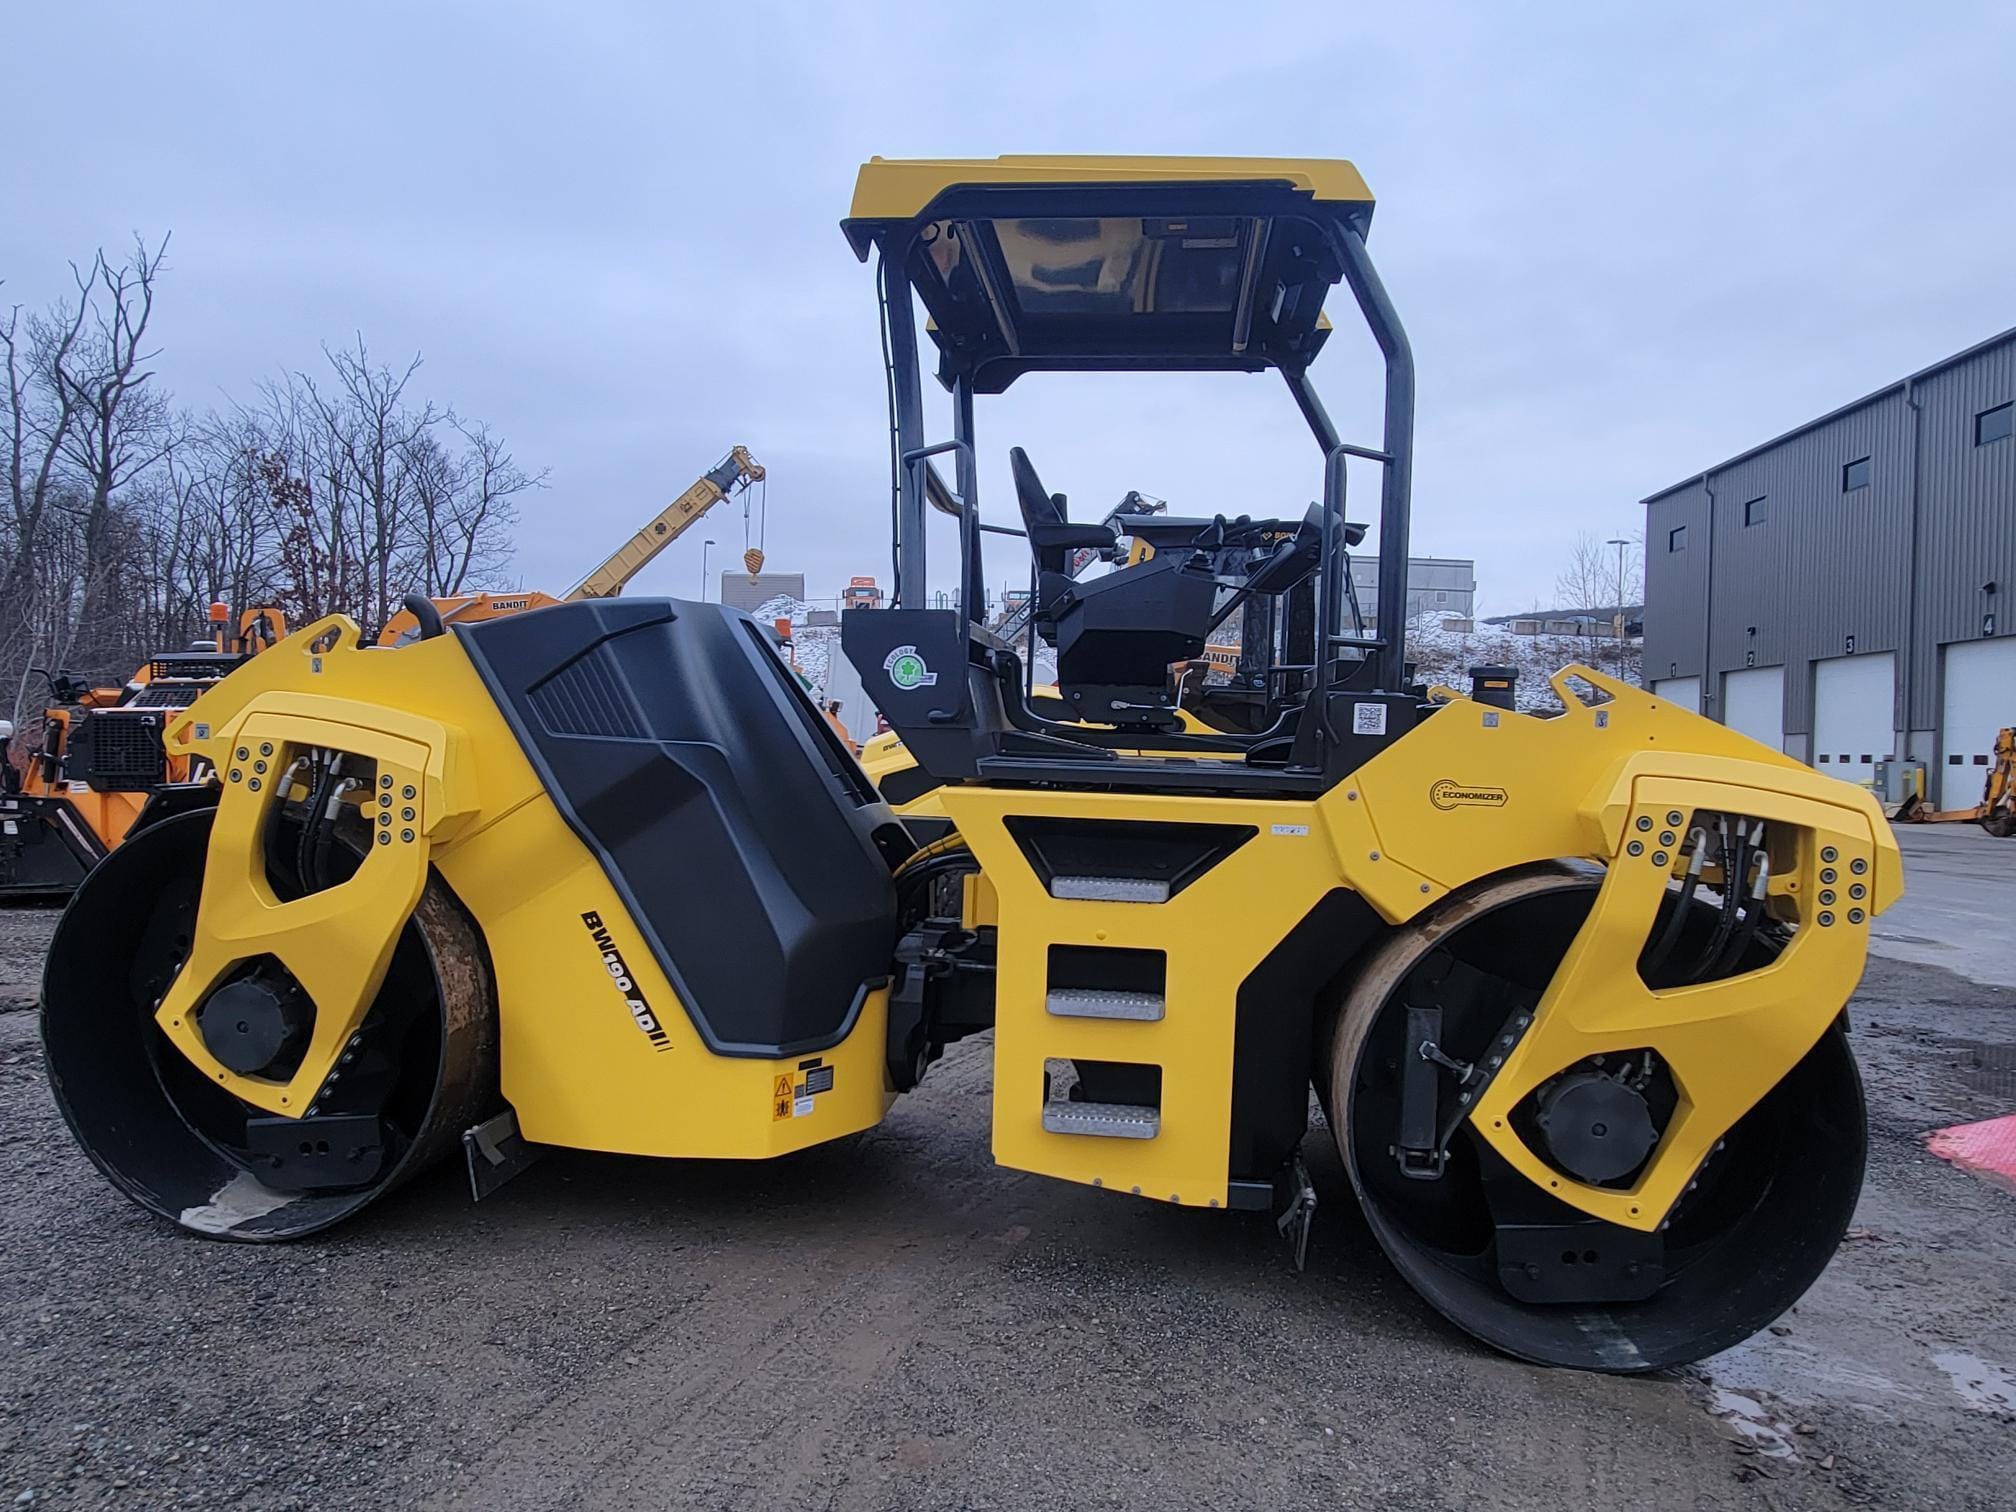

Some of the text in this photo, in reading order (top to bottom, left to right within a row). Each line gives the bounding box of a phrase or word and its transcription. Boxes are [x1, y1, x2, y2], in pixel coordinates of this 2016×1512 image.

[492, 600, 528, 609] BANDIT
[1984, 617, 1993, 634] 4
[1846, 638, 1854, 653] 3
[885, 647, 914, 669] ECOLOGY
[1747, 653, 1754, 666] 2
[1442, 791, 1504, 801] ECONOMIZER
